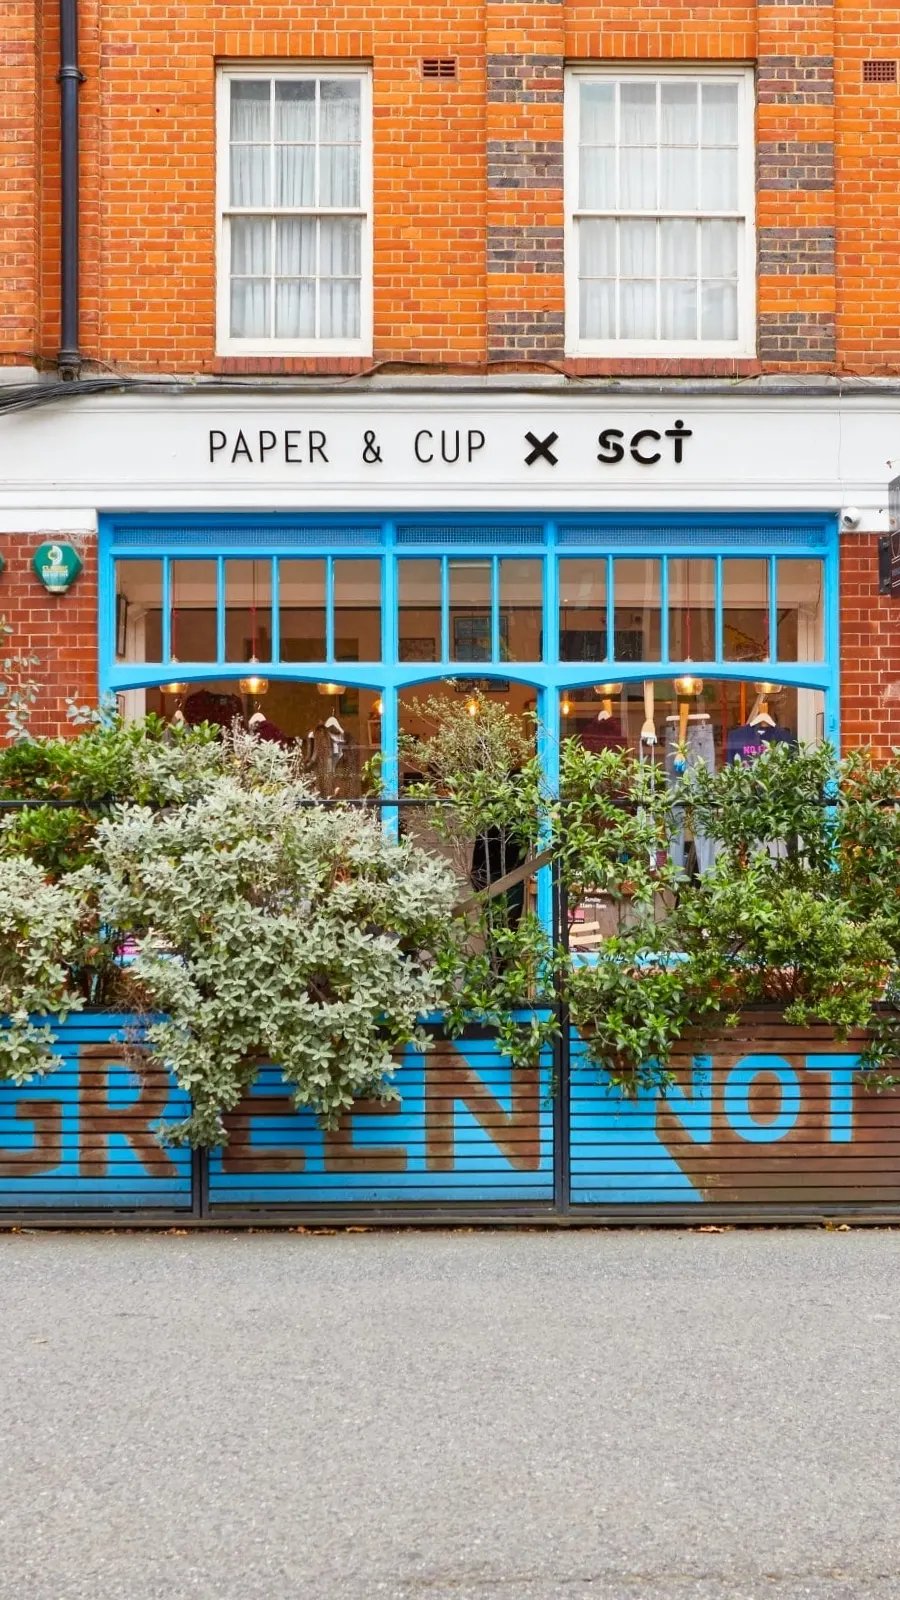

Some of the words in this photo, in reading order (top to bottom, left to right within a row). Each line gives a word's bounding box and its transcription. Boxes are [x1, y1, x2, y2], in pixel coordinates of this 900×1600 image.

[209, 430, 329, 463] PAPER
[363, 430, 383, 463] &
[414, 430, 486, 464] CUP
